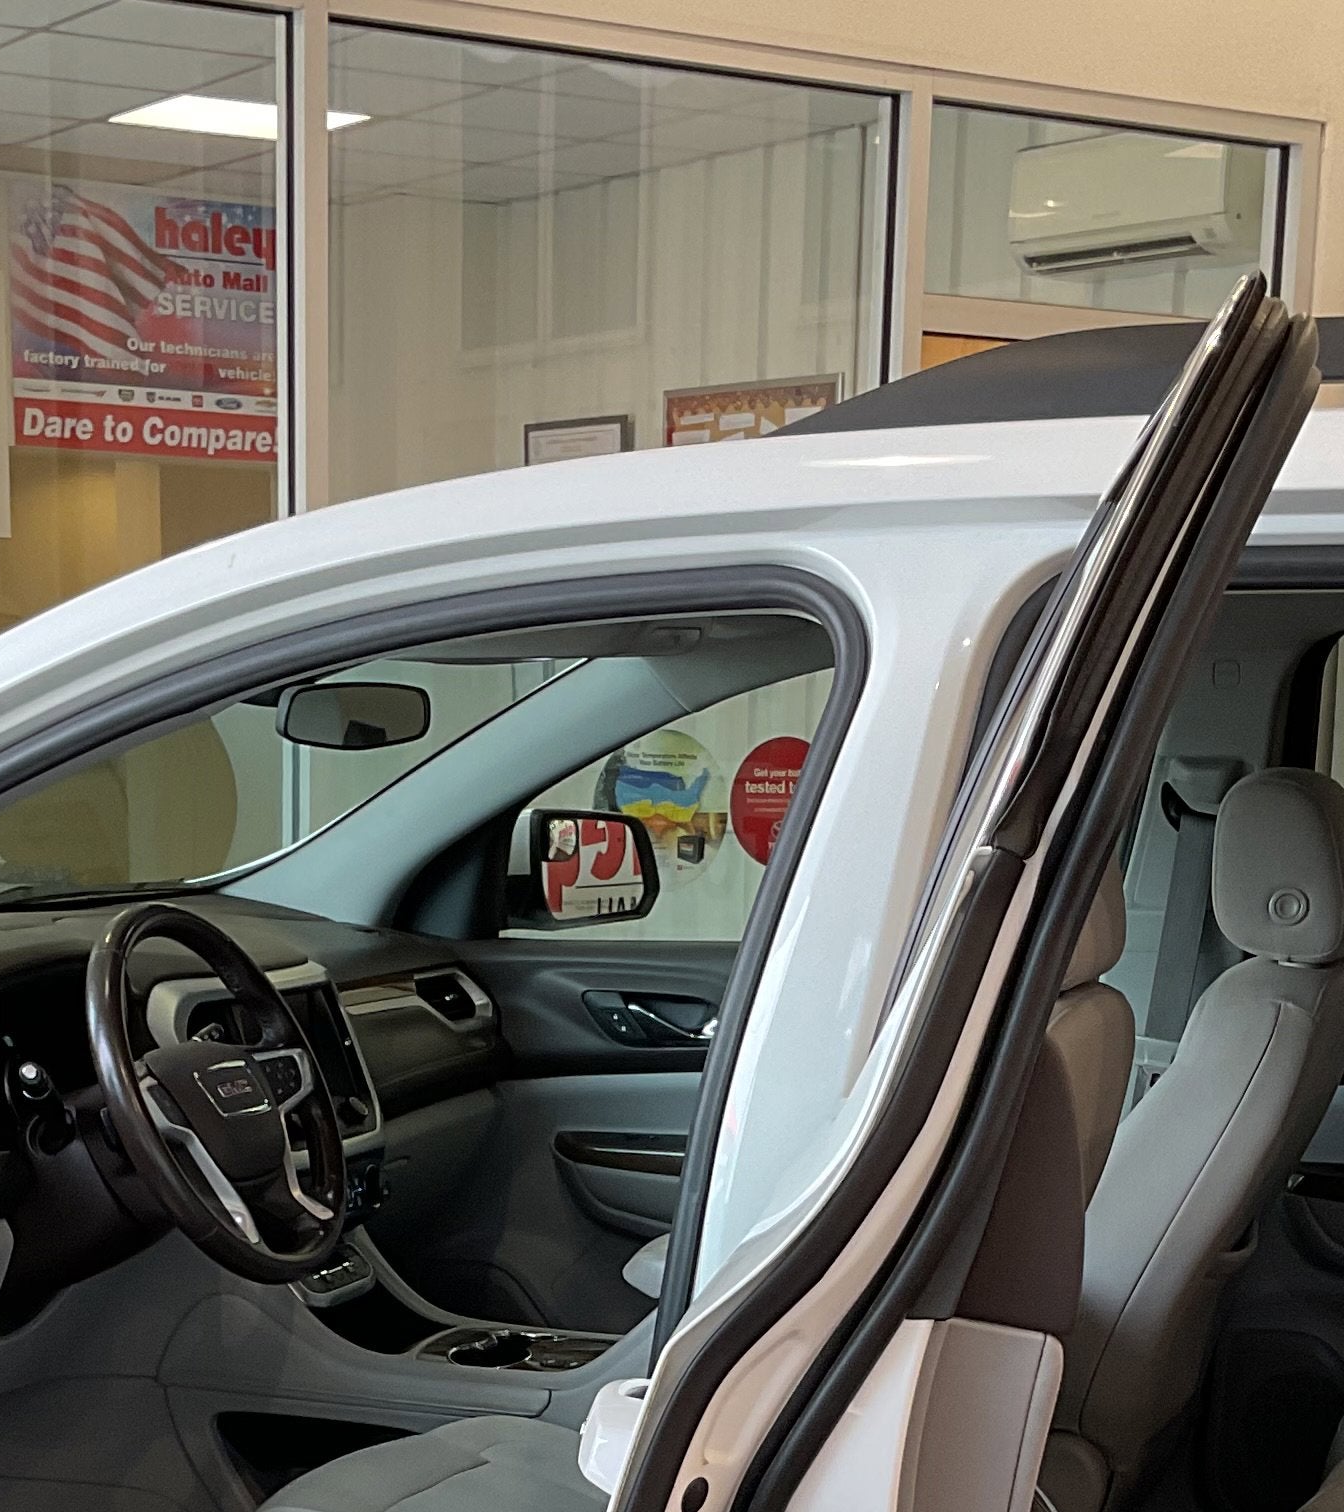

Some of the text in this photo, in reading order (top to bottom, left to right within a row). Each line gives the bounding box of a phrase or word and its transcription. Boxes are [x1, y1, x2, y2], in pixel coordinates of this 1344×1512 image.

[154, 206, 276, 271] haley
[222, 271, 268, 293] Mall
[157, 292, 275, 324] SERVICE
[126, 337, 156, 352] Our
[160, 341, 248, 361] technicians
[23, 350, 80, 369] factory
[83, 354, 140, 372] trained
[142, 359, 166, 374] for
[23, 407, 94, 440] Dare
[103, 414, 133, 443] to
[769, 769, 787, 779] your
[744, 780, 786, 794] tested
